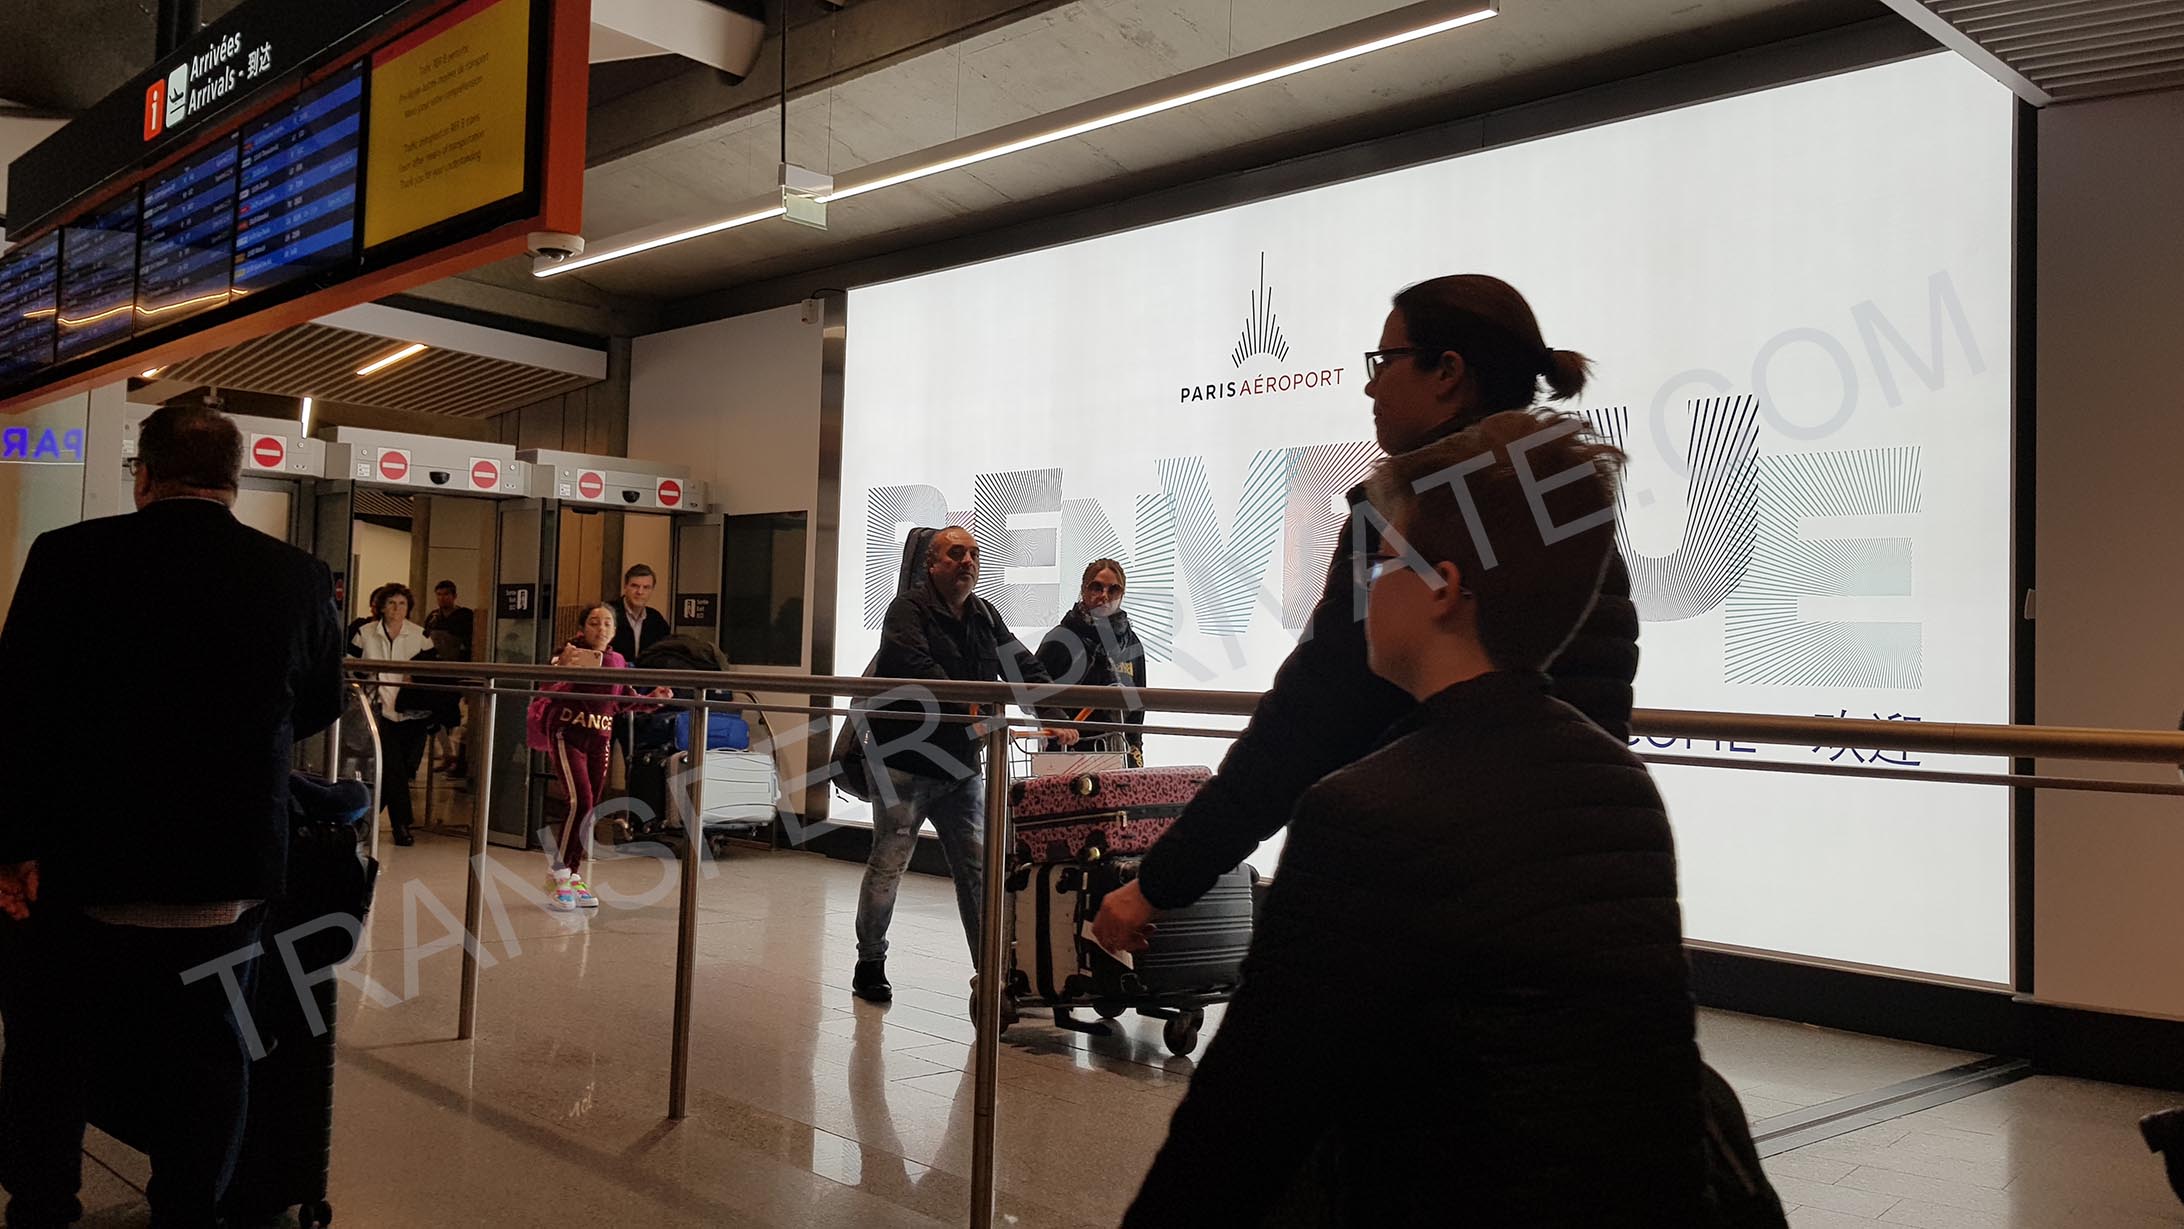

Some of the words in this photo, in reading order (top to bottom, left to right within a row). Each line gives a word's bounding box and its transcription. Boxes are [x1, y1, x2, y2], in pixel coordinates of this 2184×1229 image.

[188, 65, 236, 115] Arrivals
[247, 41, 272, 79] 到达
[190, 32, 241, 82] Arrivées
[1181, 382, 1236, 403] PARIS
[1239, 368, 1344, 396] AÉROPORT
[560, 707, 613, 731] DANCE
